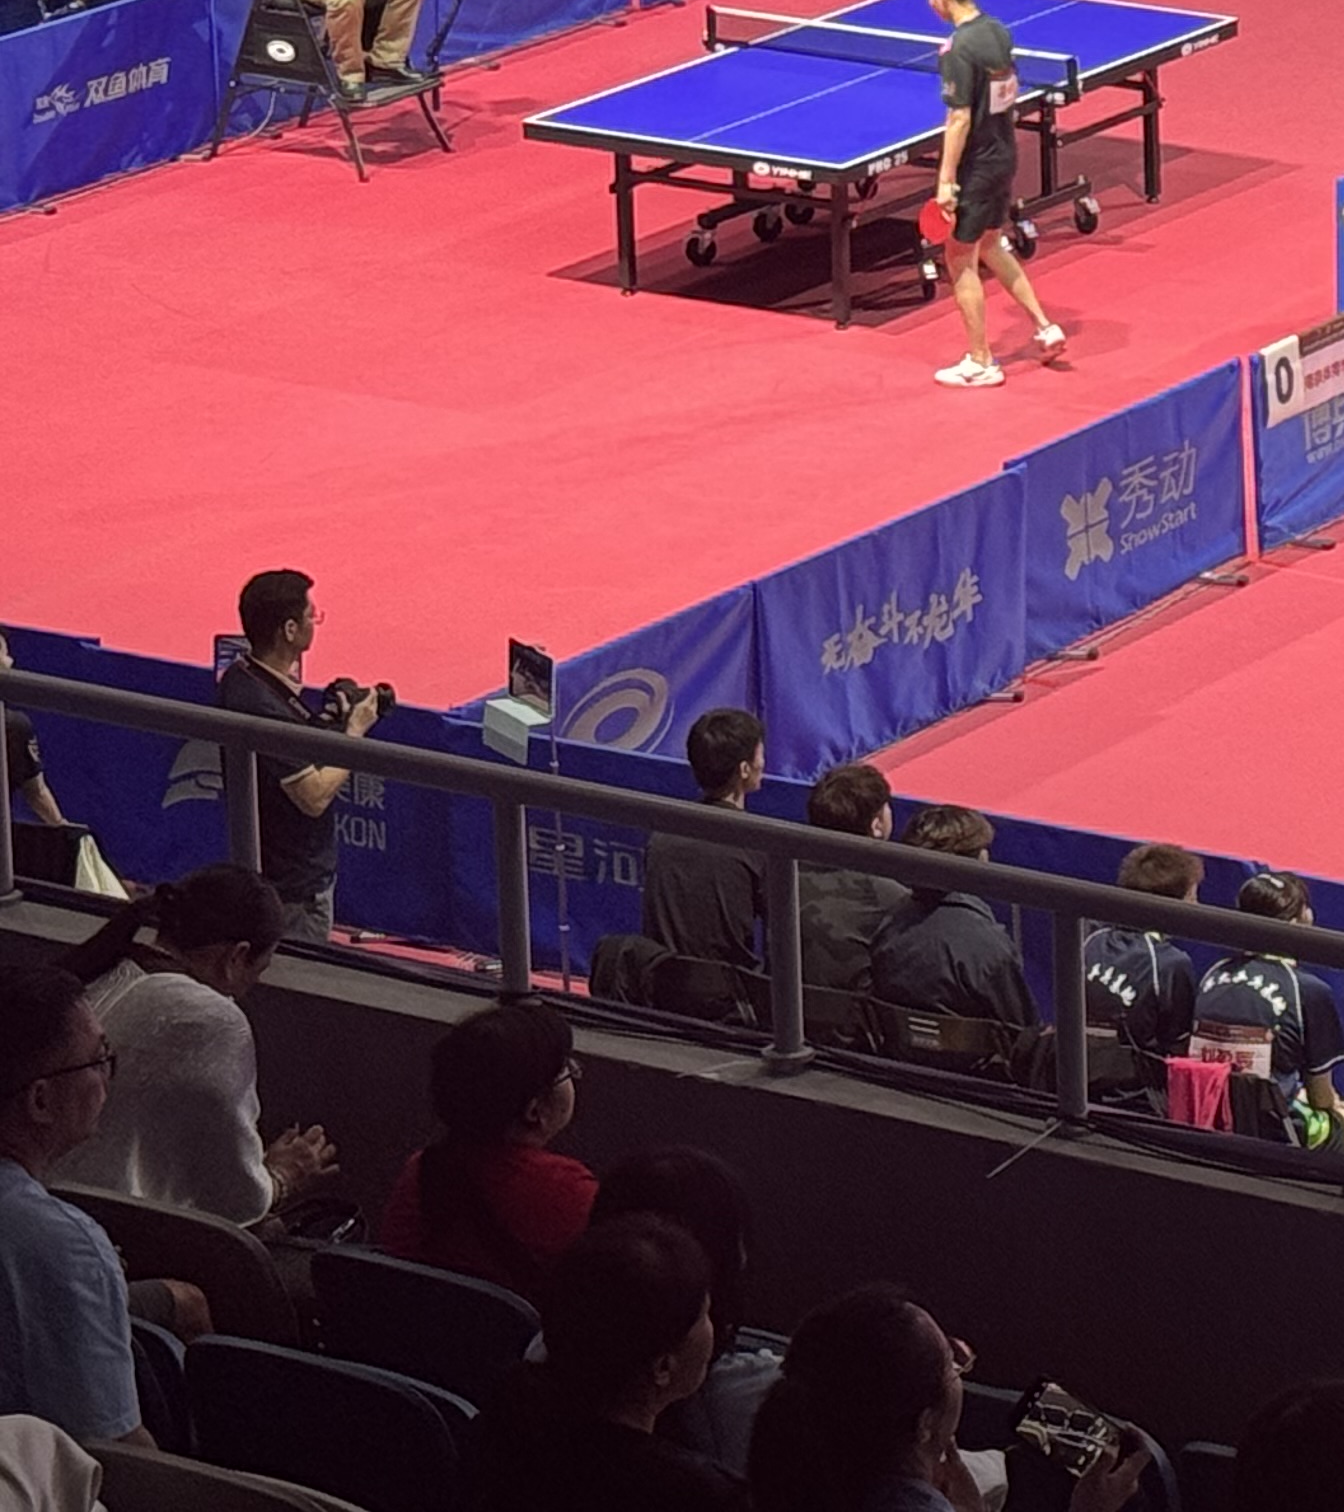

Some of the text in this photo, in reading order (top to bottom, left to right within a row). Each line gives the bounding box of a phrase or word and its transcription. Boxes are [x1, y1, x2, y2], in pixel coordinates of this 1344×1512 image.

[84, 56, 173, 109] 双鱼体育
[1273, 355, 1295, 405] 0
[1118, 439, 1198, 530] 秀动
[1119, 501, 1198, 557] ShowStart
[820, 567, 983, 676] 无奋斗不龙华
